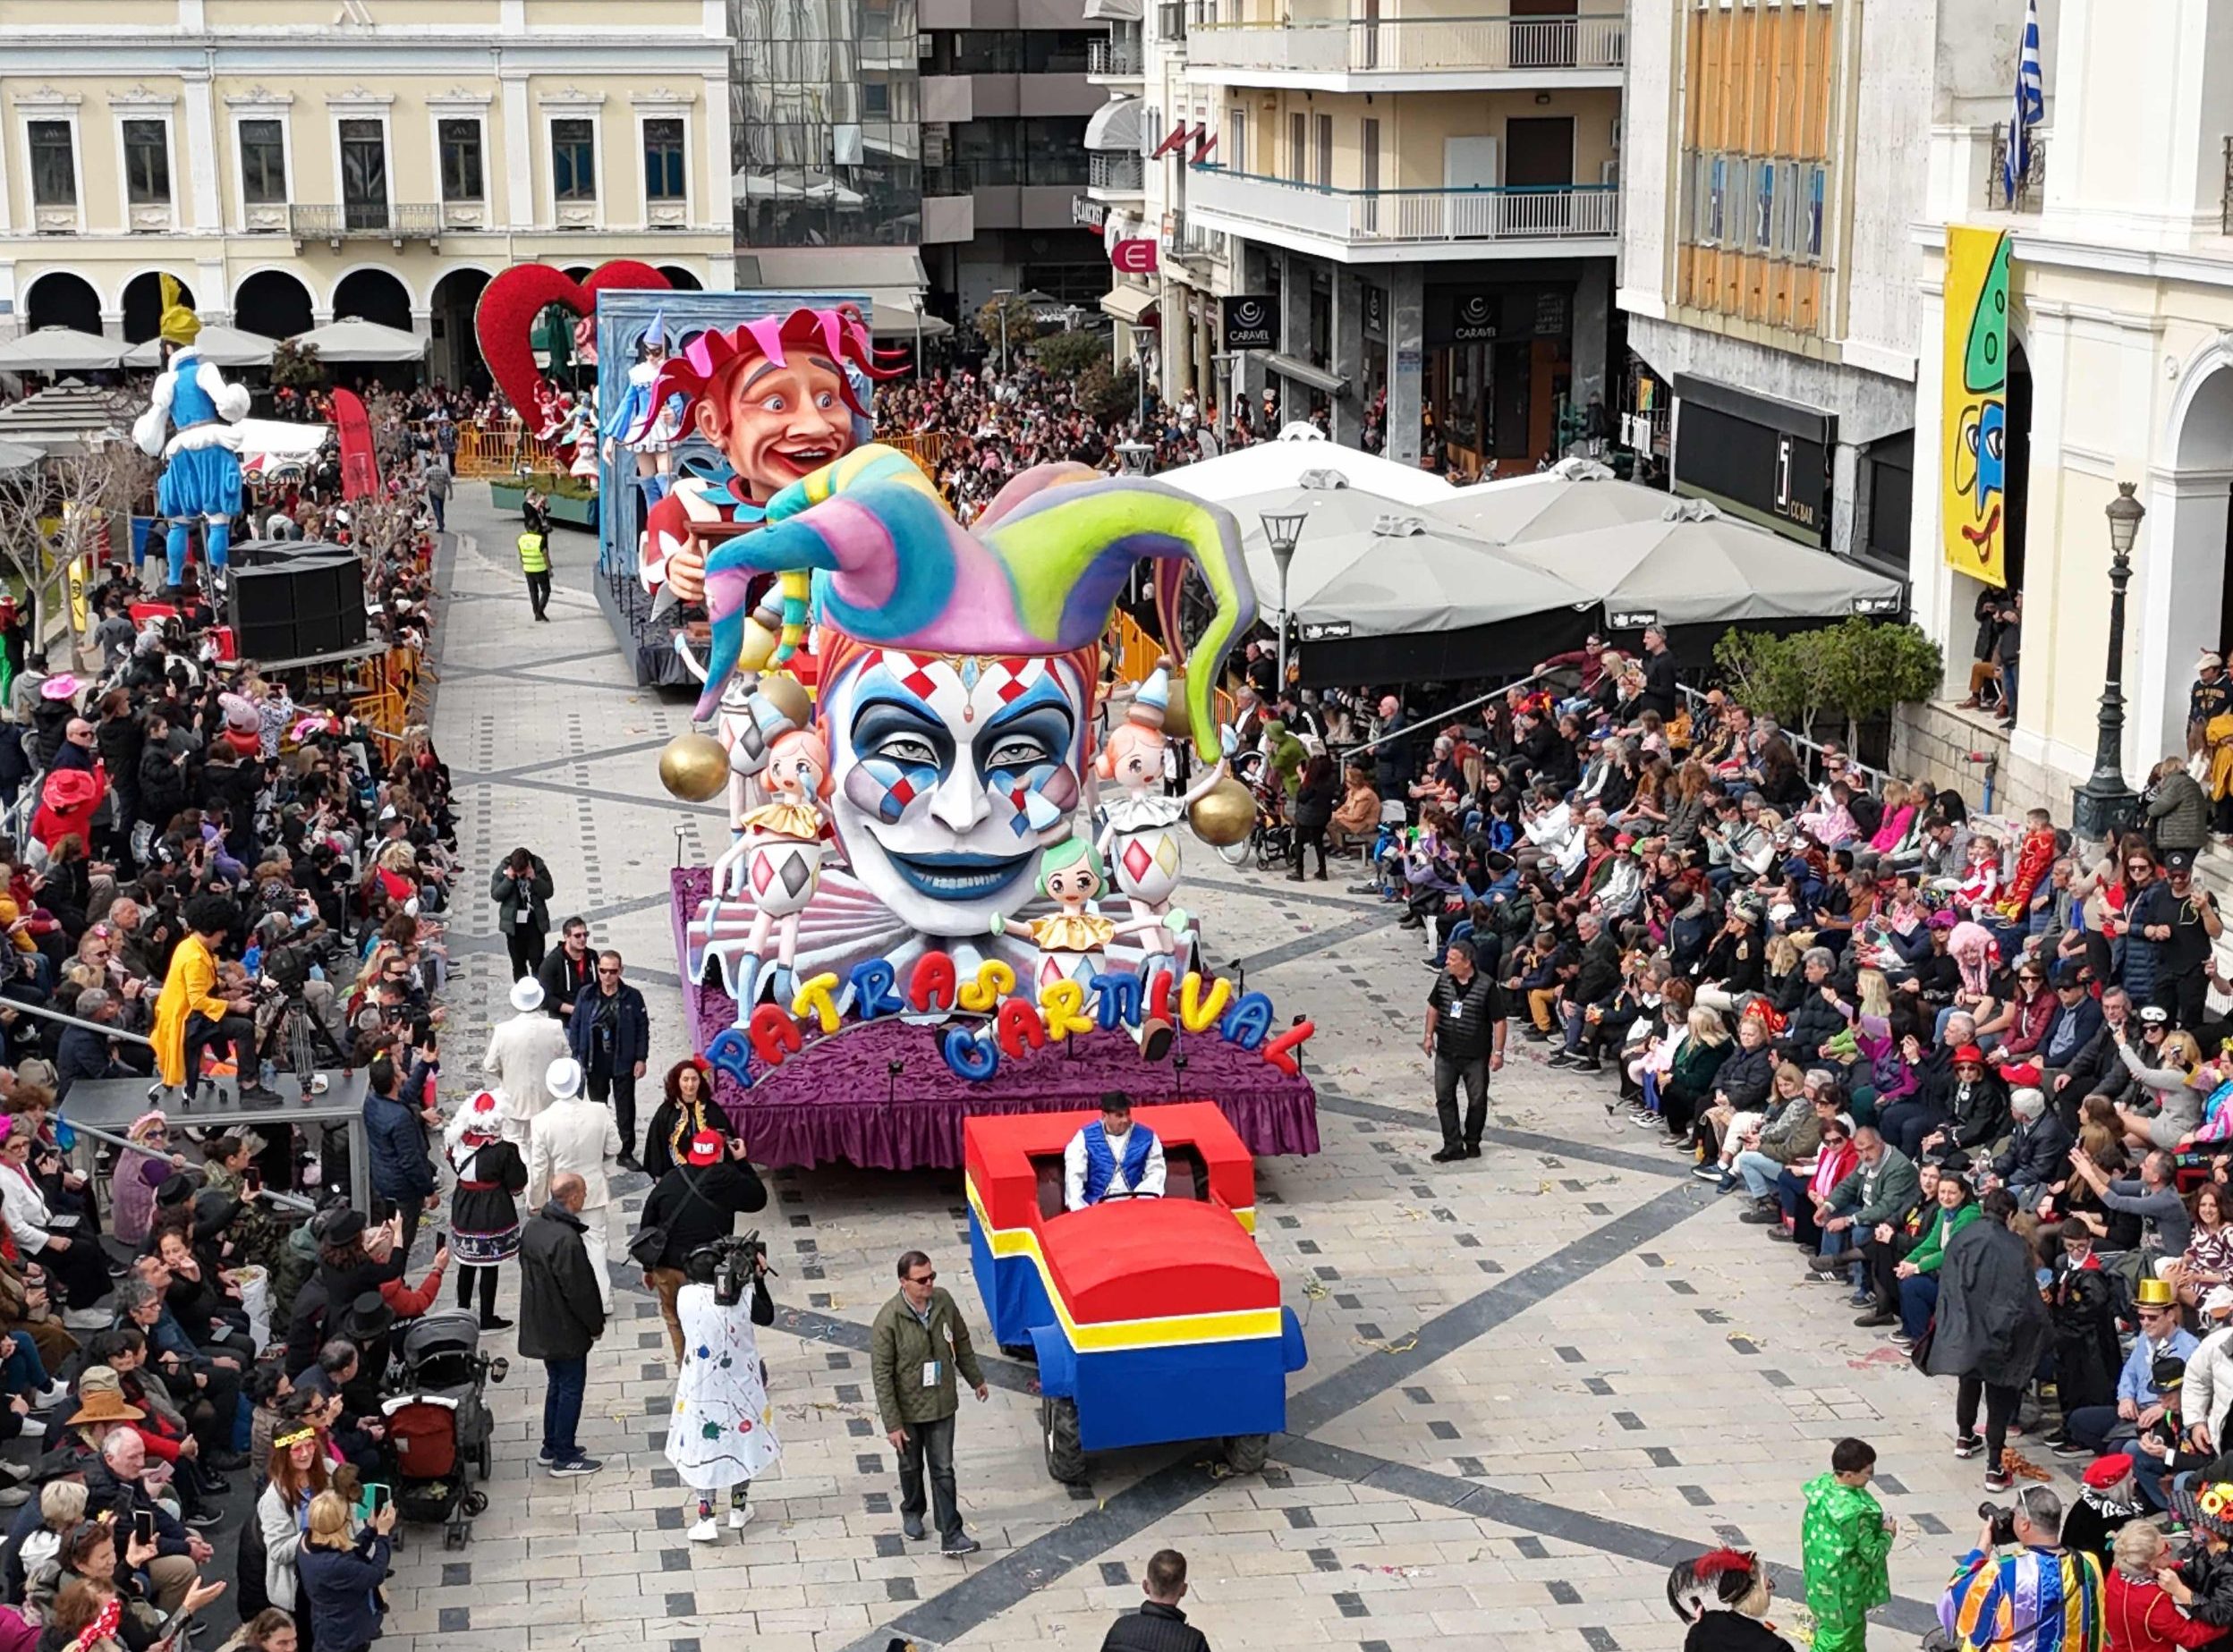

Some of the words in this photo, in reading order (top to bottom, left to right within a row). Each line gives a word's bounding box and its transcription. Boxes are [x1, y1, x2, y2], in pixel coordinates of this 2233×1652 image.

[1229, 329, 1269, 341] CARAVEL
[1455, 326, 1497, 339] CARAVEL
[705, 951, 1016, 1089] PATRAS
